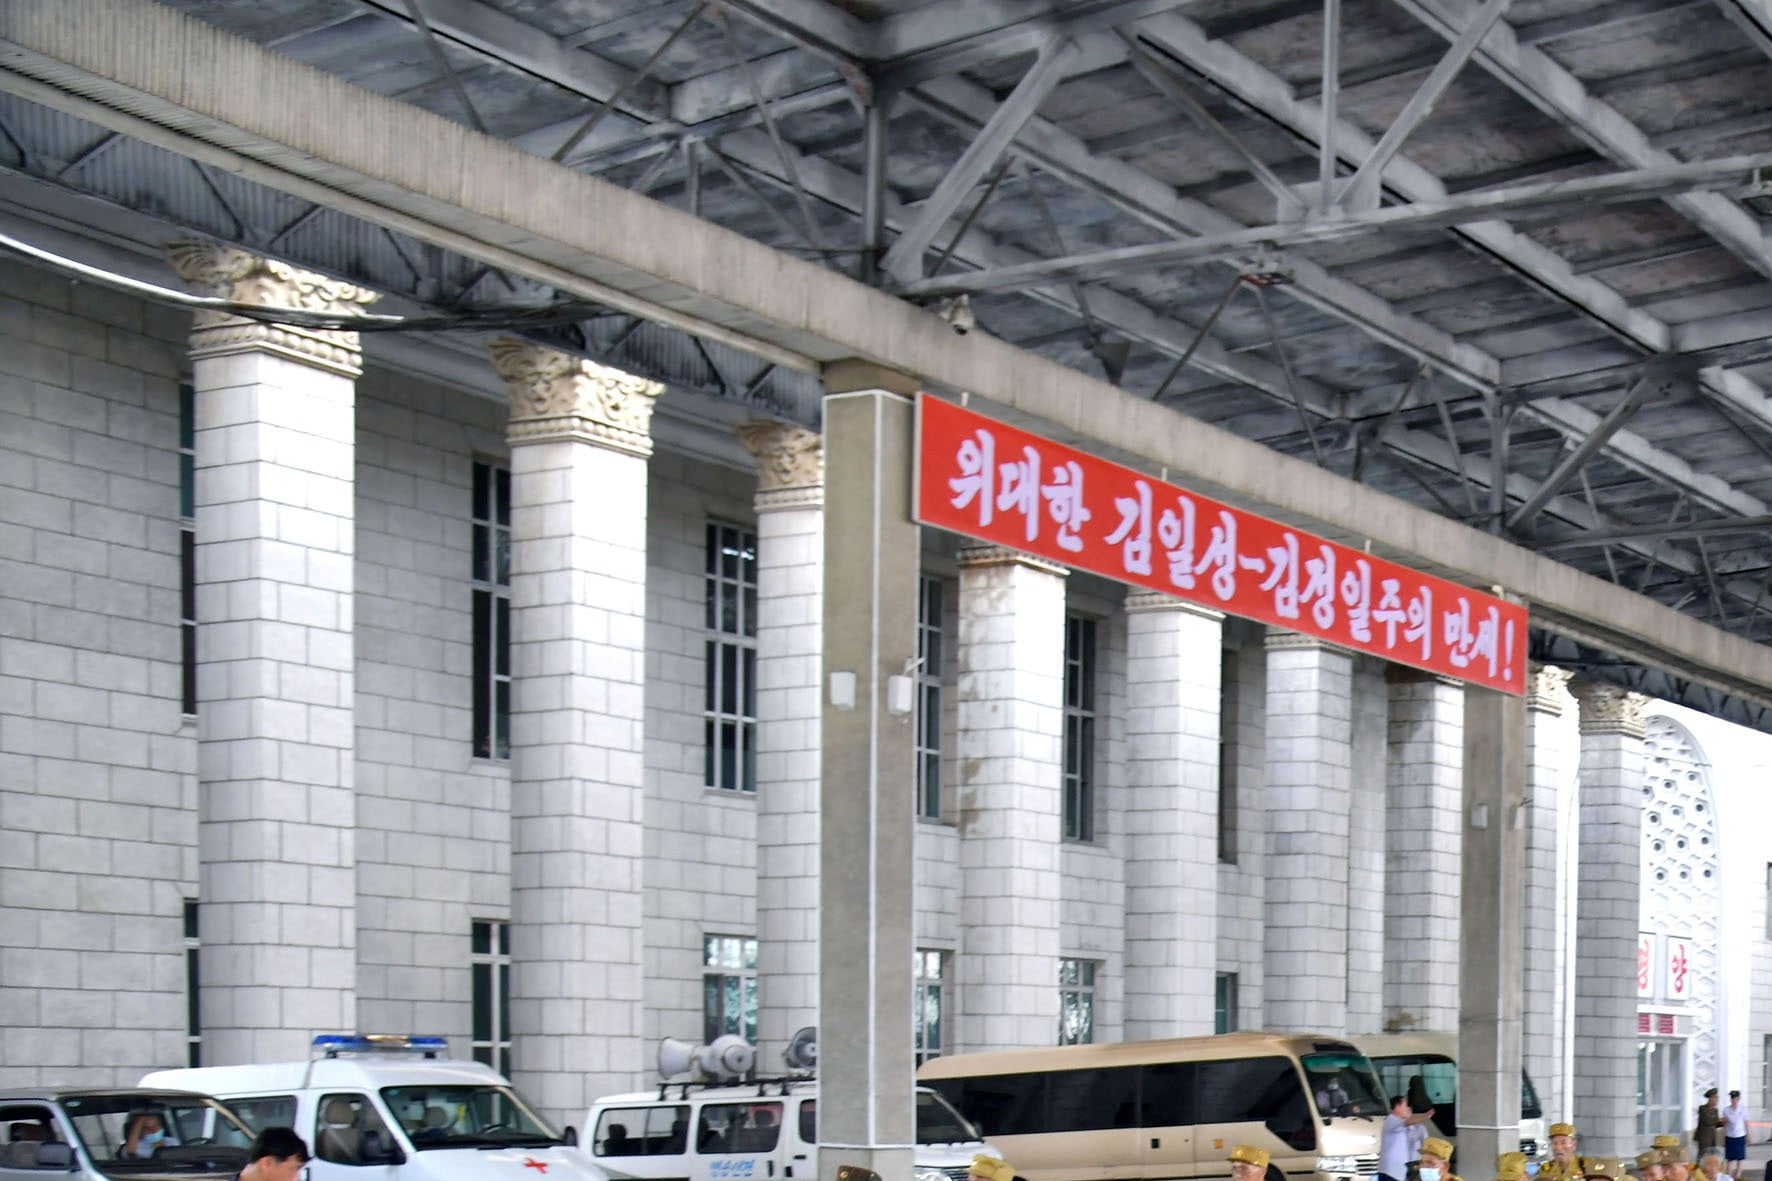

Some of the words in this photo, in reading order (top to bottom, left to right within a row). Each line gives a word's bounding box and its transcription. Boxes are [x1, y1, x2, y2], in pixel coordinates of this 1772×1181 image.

[949, 429, 1091, 552] 위대한
[1106, 480, 1431, 660] 김일성-김정일주의
[1444, 599, 1514, 681] 만세!
